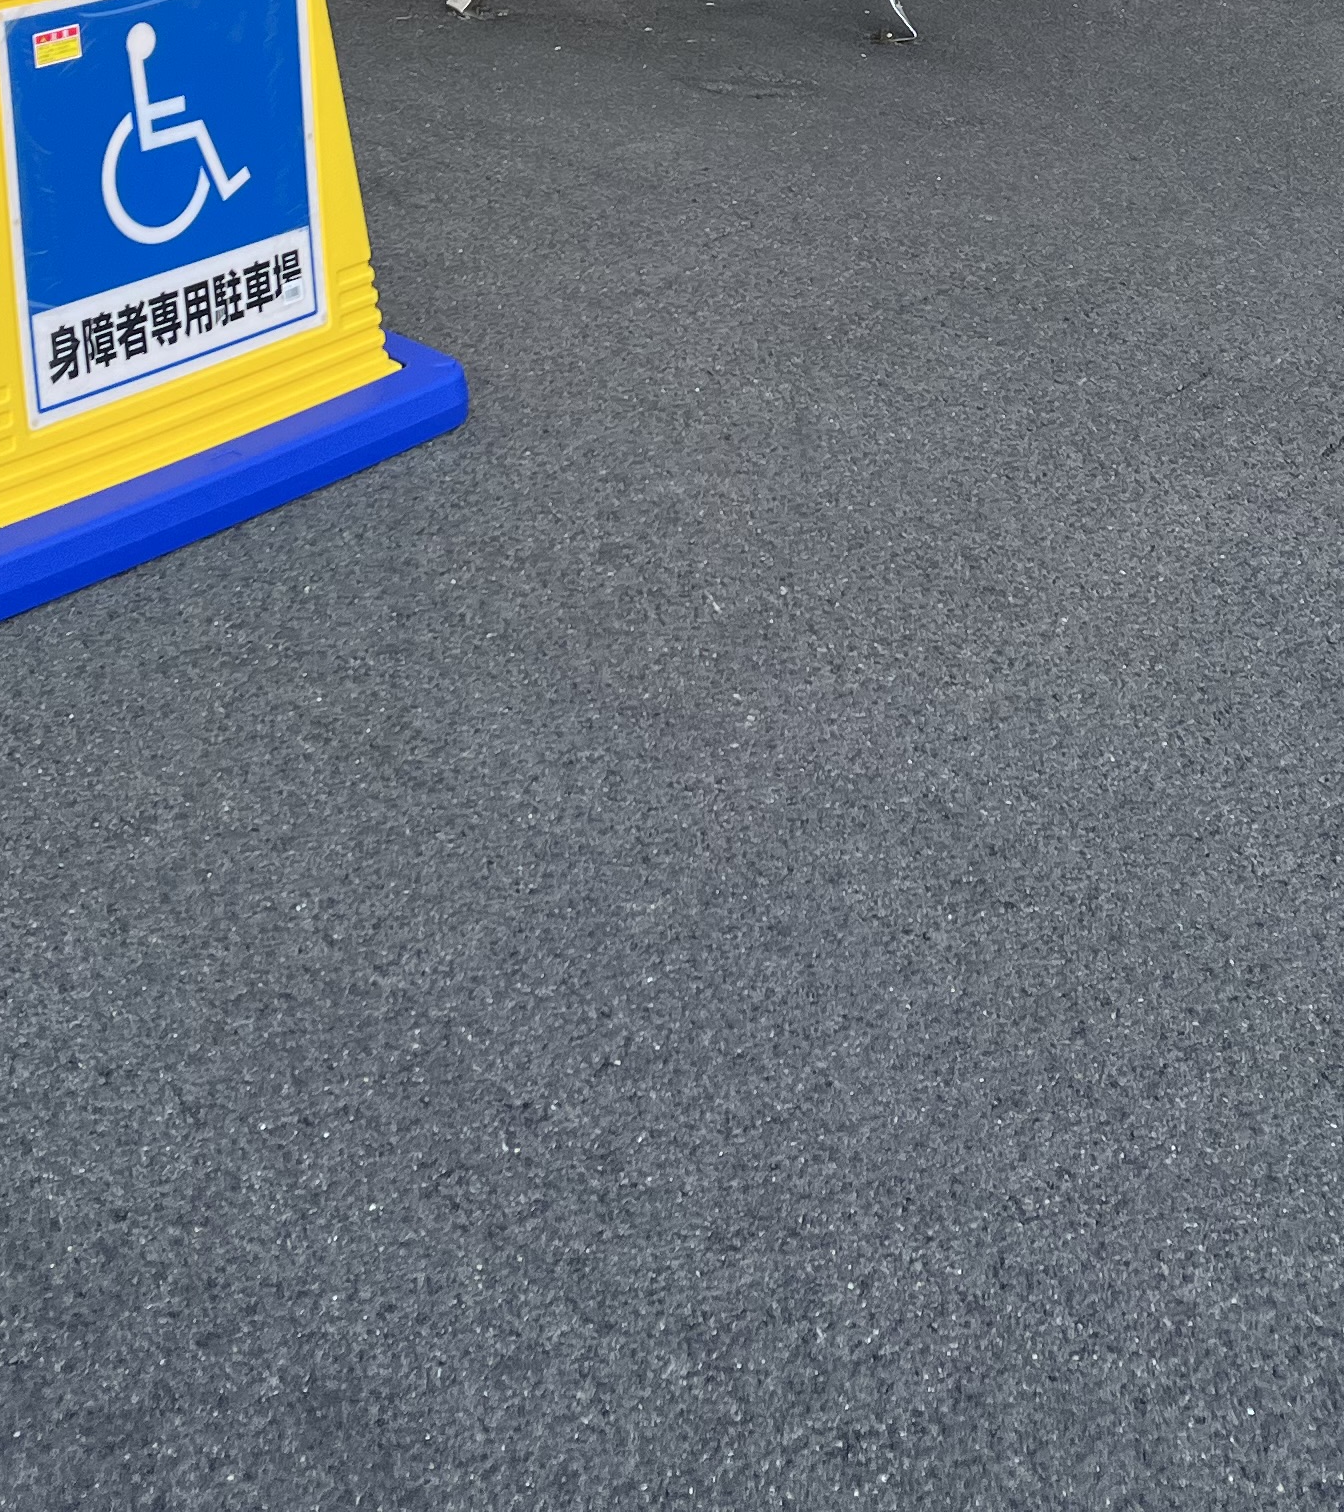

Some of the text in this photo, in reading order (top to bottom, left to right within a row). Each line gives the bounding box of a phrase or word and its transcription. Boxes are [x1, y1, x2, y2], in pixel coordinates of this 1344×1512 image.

[48, 248, 302, 385] 身障者専用駐車場
